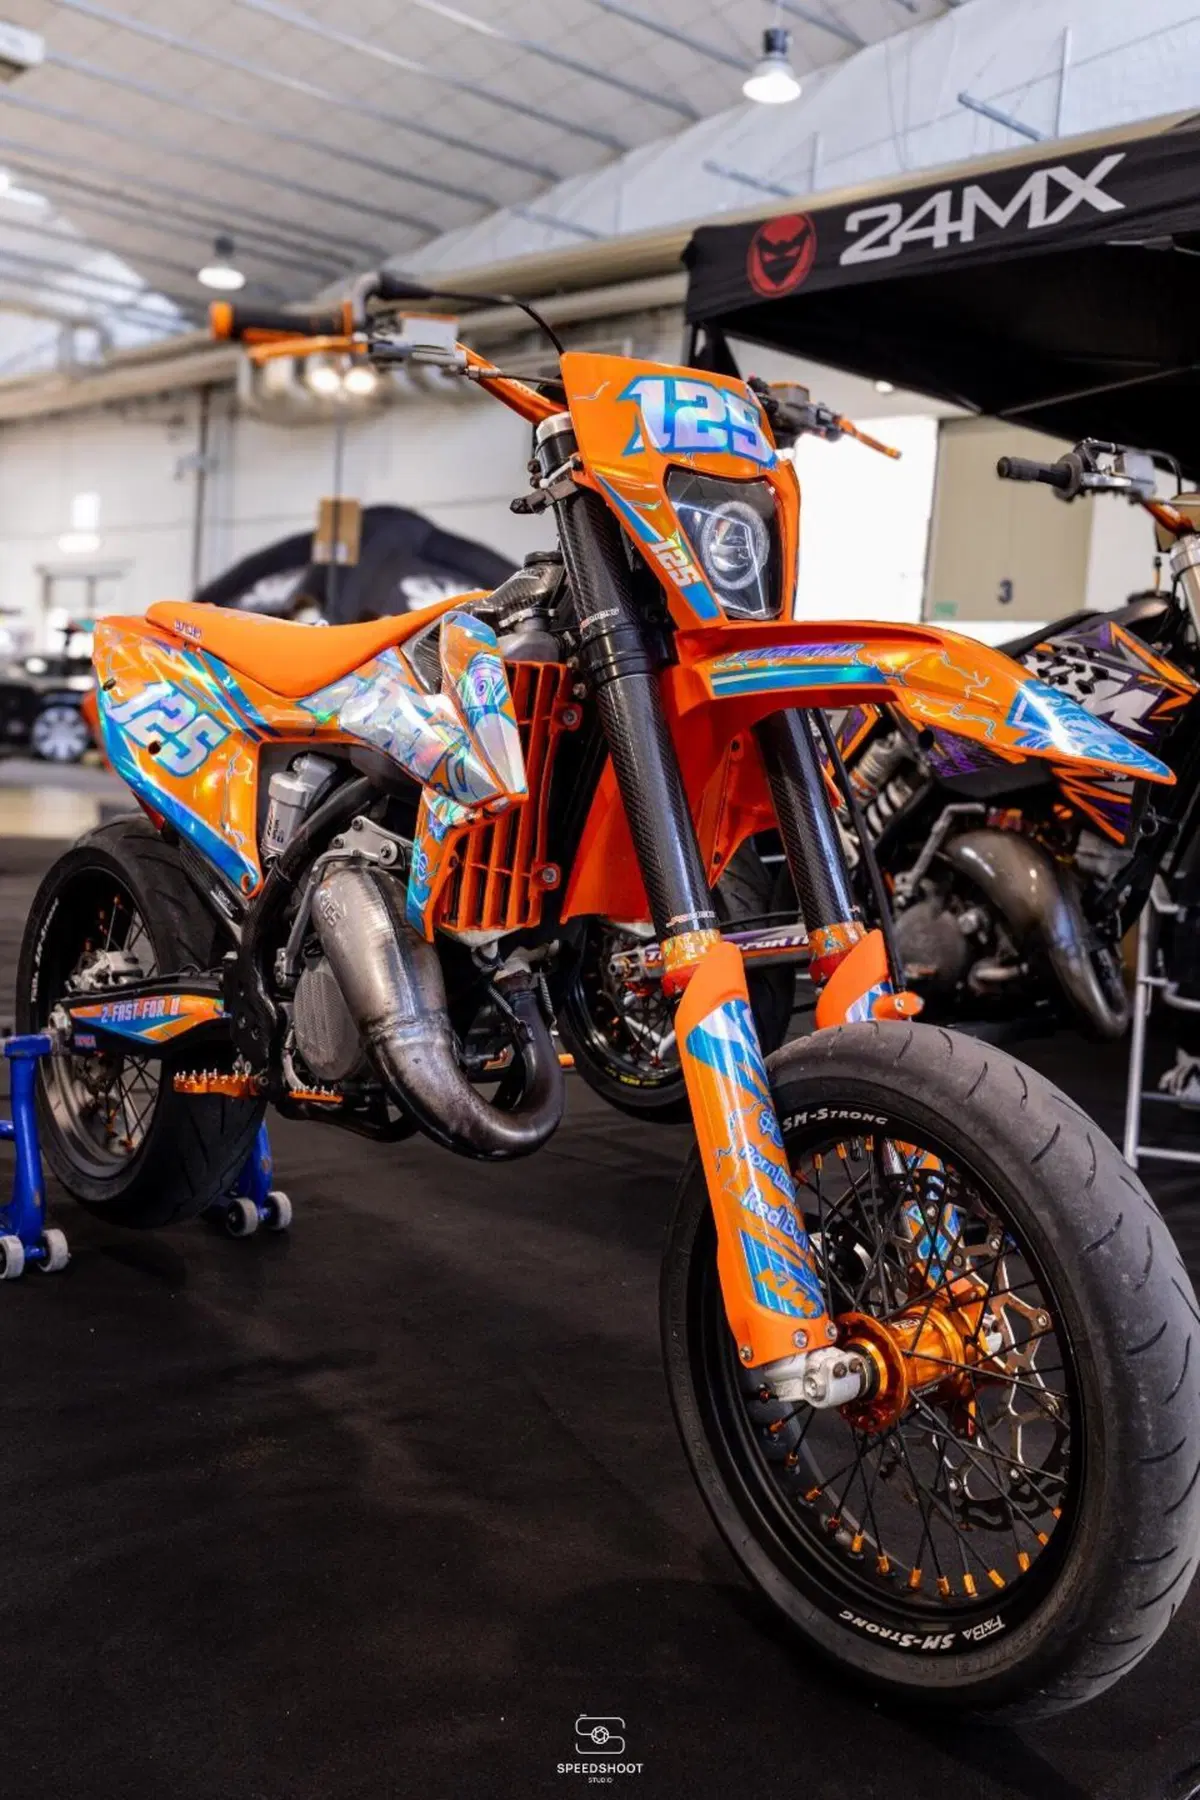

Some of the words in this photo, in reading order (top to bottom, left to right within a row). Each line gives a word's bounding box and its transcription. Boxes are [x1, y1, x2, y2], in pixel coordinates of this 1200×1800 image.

[839, 152, 1127, 266] 24MX
[618, 377, 777, 468] 125
[647, 530, 704, 587] 125
[997, 579, 1013, 605] 3
[104, 681, 231, 777] 125
